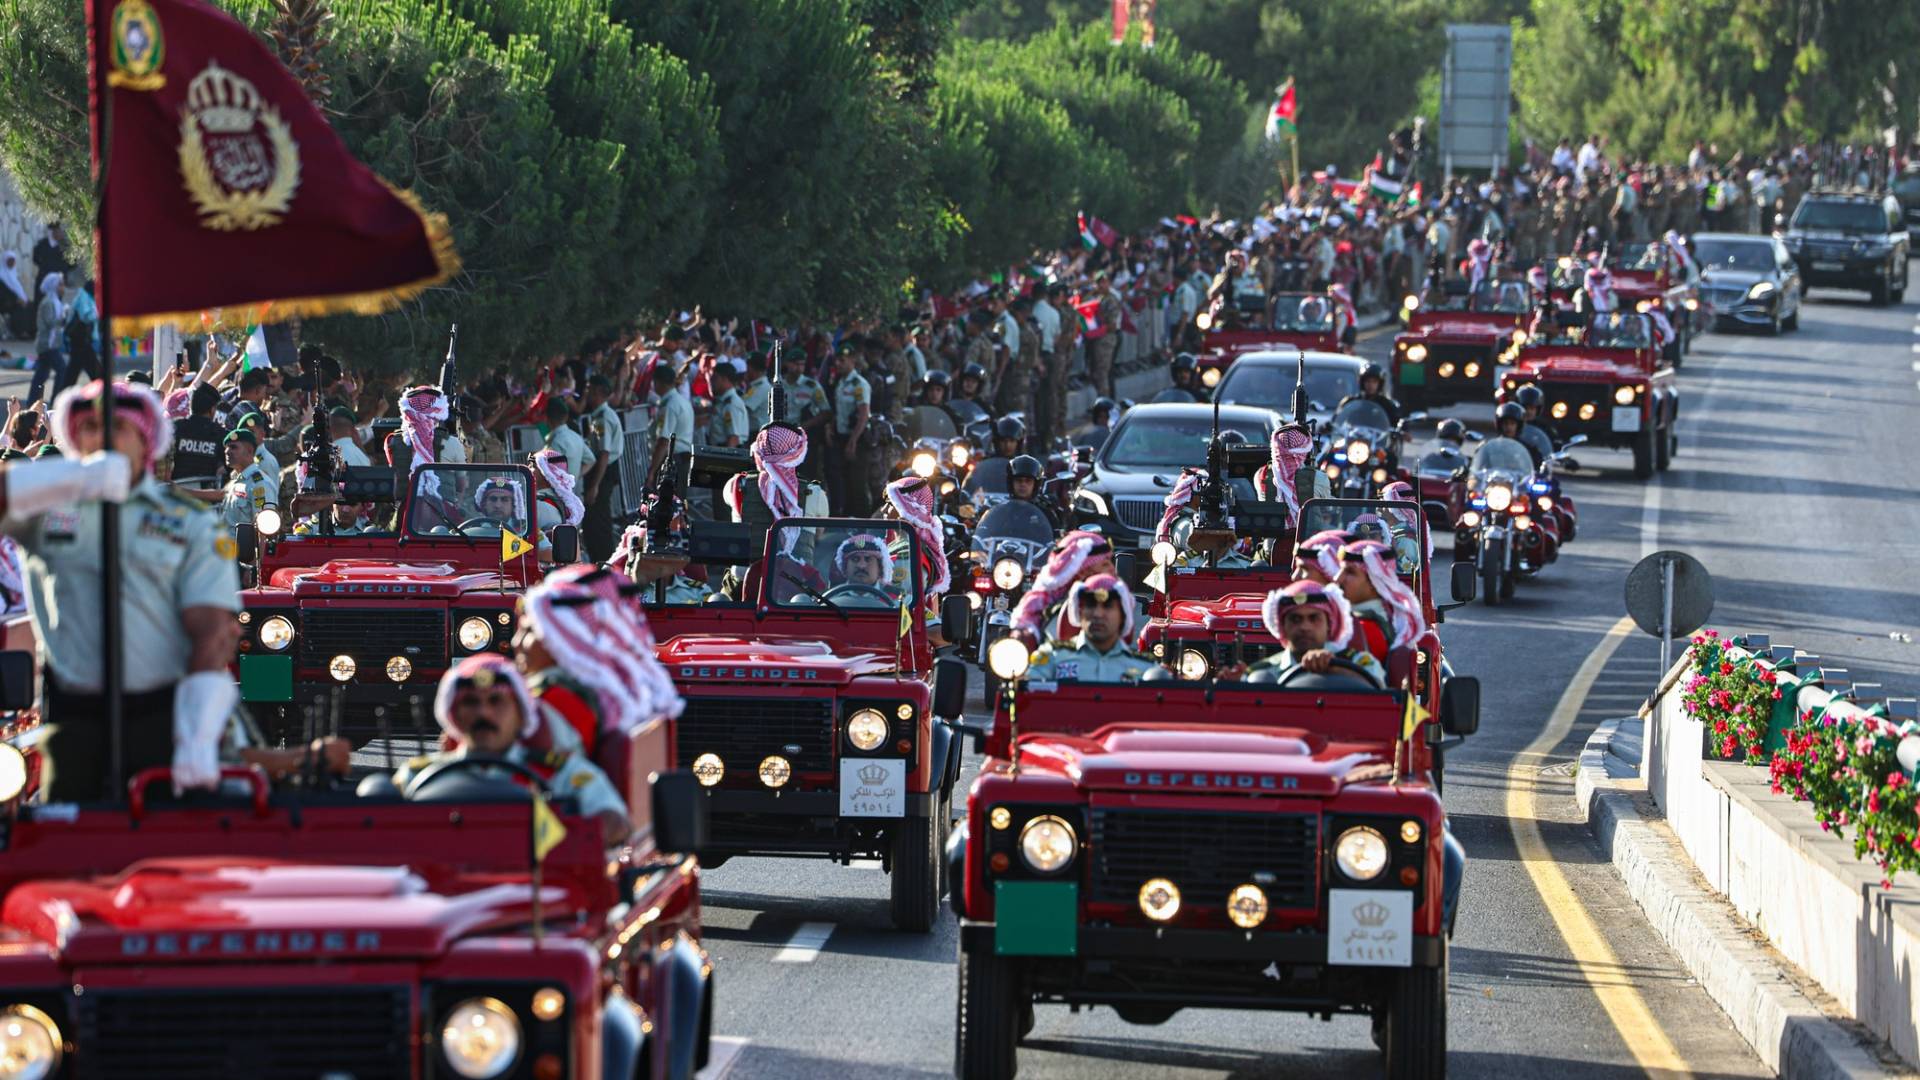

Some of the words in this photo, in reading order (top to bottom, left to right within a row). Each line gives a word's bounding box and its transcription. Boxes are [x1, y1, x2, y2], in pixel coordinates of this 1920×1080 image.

[179, 439, 216, 455] POLICE
[320, 584, 432, 593] DEFENDER
[681, 667, 817, 679] DEFENDER
[1124, 772, 1298, 788] DEFENDER
[121, 931, 380, 955] DEFENDER
